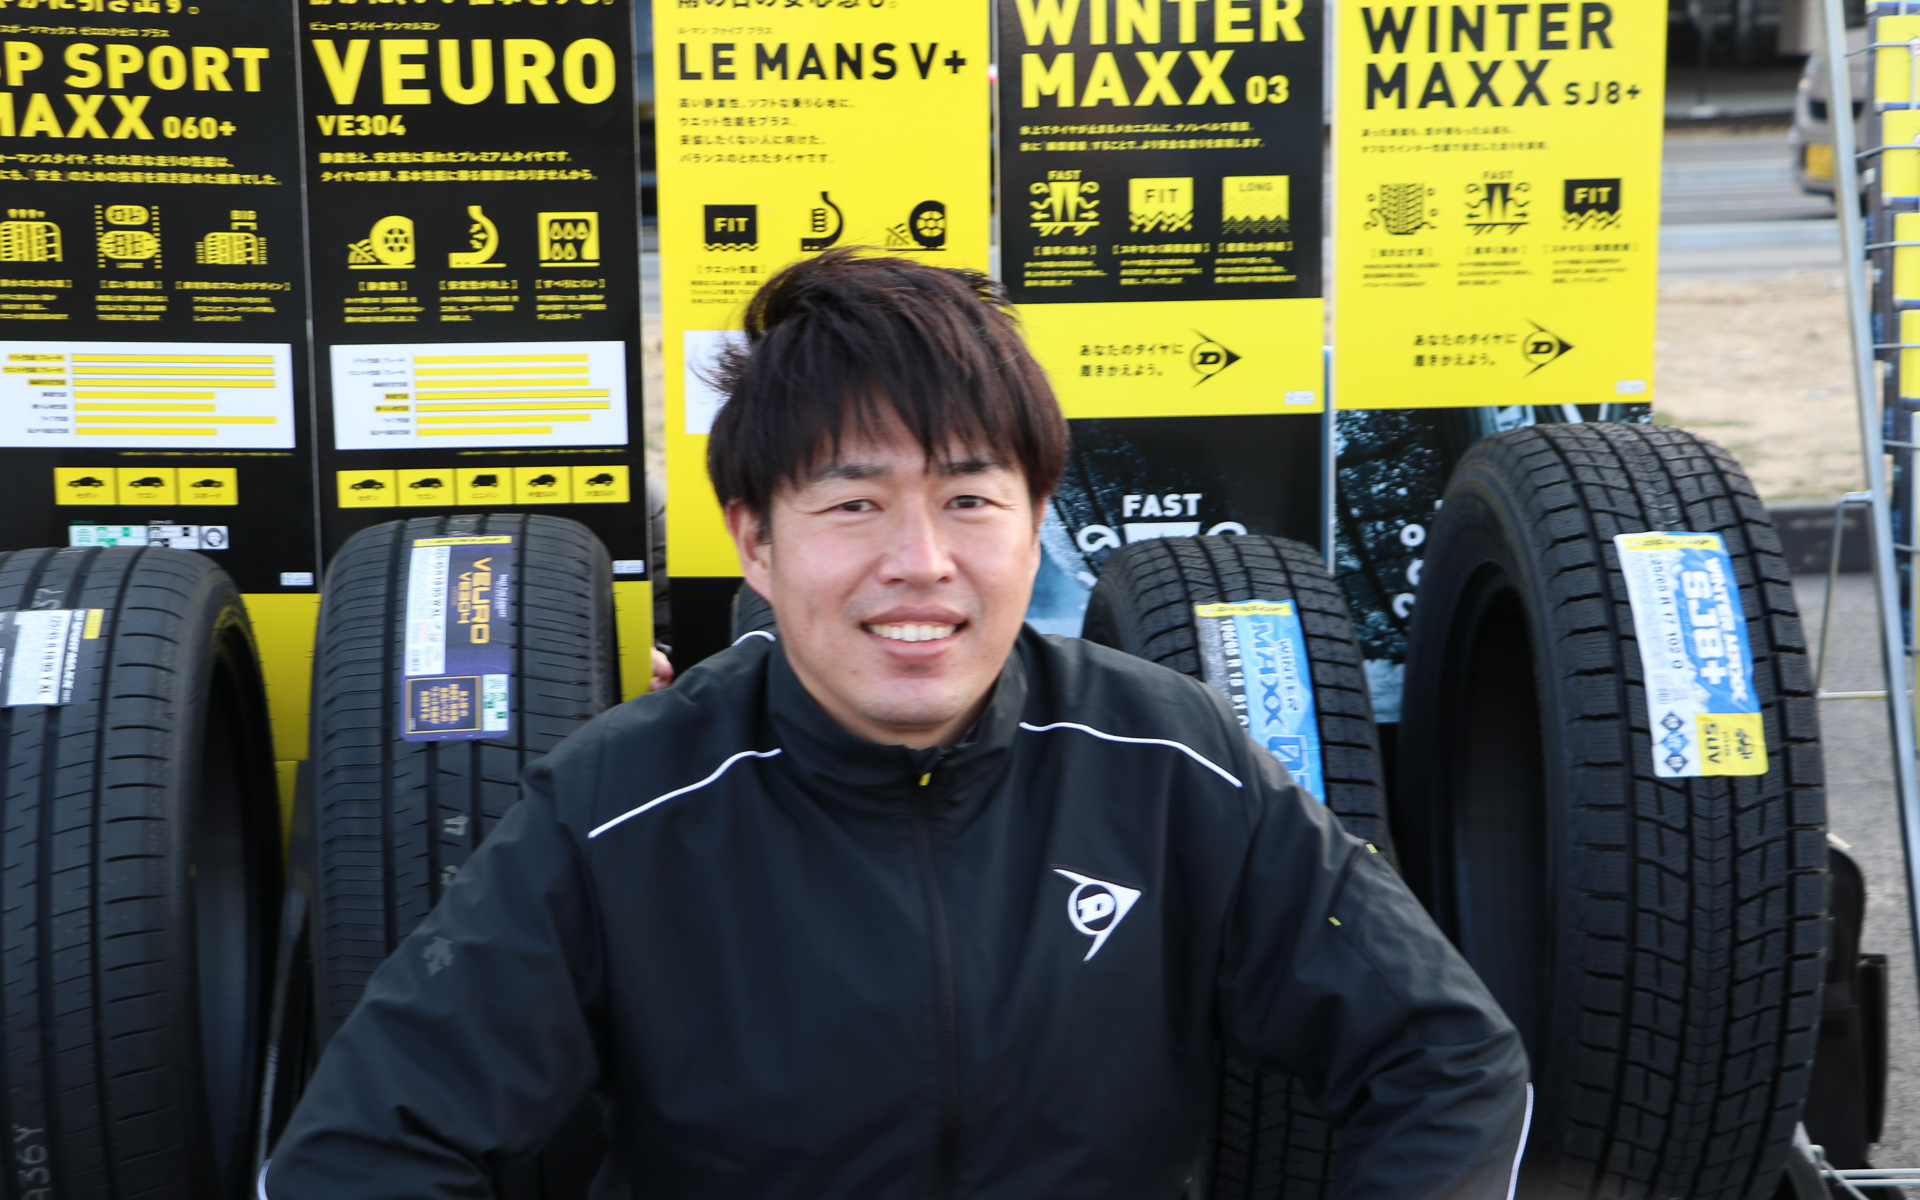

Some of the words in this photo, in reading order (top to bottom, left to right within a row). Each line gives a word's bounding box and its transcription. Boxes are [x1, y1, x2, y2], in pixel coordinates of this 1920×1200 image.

[1015, 0, 1305, 45] WINTER
[1361, 2, 1614, 54] WINTER
[0, 41, 44, 87] P
[63, 43, 270, 92] SPORT
[311, 38, 616, 105] VEURO
[678, 43, 736, 80] LE
[755, 43, 898, 80] MANS
[1021, 50, 1235, 108] MAXX
[1245, 75, 1289, 104] 03
[1366, 59, 1551, 110] MAXX
[1564, 81, 1640, 105] SJ8+
[162, 116, 237, 139] 060+
[316, 115, 406, 136] VE304
[1048, 170, 1081, 181] FAST
[1144, 188, 1180, 204] FIT
[1483, 171, 1513, 180] FAST
[1573, 187, 1613, 204] FIT
[713, 217, 749, 232] FIT
[1079, 343, 1184, 356] あなたのタイヤに
[1414, 333, 1518, 346] あなたのタイヤに
[1122, 493, 1202, 518] FAST
[457, 571, 472, 624] VE304
[470, 557, 493, 644] VEURO
[1680, 570, 1728, 685] SJ8+
[1246, 622, 1290, 734] MAXX
[1275, 637, 1301, 713] WINTER
[1702, 722, 1722, 765] SUV
